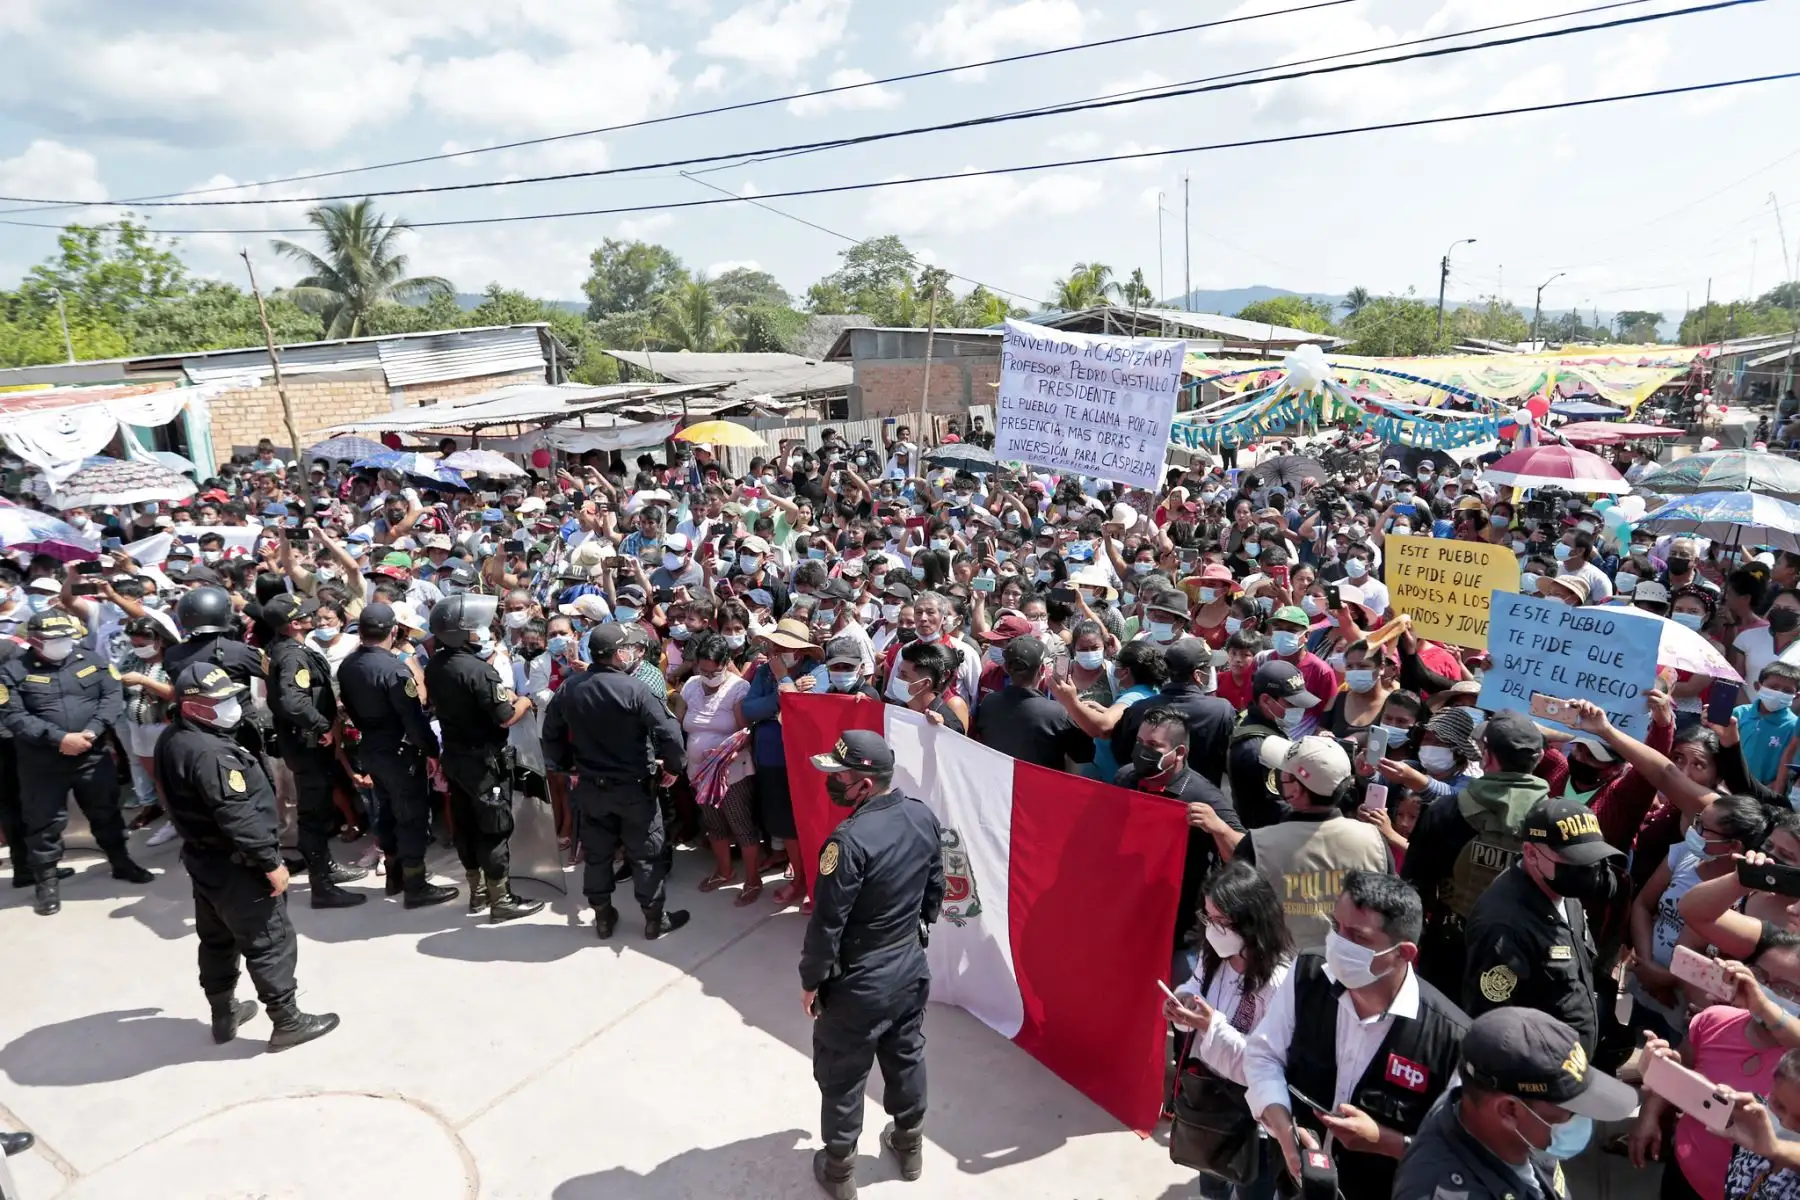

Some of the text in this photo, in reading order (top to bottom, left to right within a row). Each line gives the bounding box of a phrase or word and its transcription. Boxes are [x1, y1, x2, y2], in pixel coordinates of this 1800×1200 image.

[1003, 328, 1077, 356] BIENVENIDO
[1002, 352, 1061, 377] PROFESOR
[1070, 360, 1106, 382] PEDRO
[1111, 368, 1168, 393] CASTILLO
[1038, 379, 1116, 406] PRESIDENTE
[1002, 396, 1013, 410] EL
[1018, 397, 1057, 415] PUEBLO
[1064, 404, 1077, 420] TE
[1081, 408, 1120, 427] ACLAMA
[1128, 415, 1146, 431] POR
[1068, 426, 1092, 442] MAS
[1098, 431, 1130, 450] OBRAS
[1139, 439, 1147, 453] E
[1074, 448, 1097, 463] PARA
[1101, 452, 1156, 479] CASPIZAPA
[1400, 544, 1490, 566] ESTE PUEBLO
[1397, 563, 1483, 589] TE PIDE QUE
[1397, 584, 1490, 609] APOYES A LOS
[1444, 613, 1454, 628] Y
[1509, 603, 1615, 636] ESTE PUEBLO
[1509, 629, 1624, 669] TE PIDE QUE
[1500, 679, 1526, 701] DEL
[1503, 654, 1639, 699] BAJE EL PRECIO
[1518, 1083, 1547, 1092] PERU
